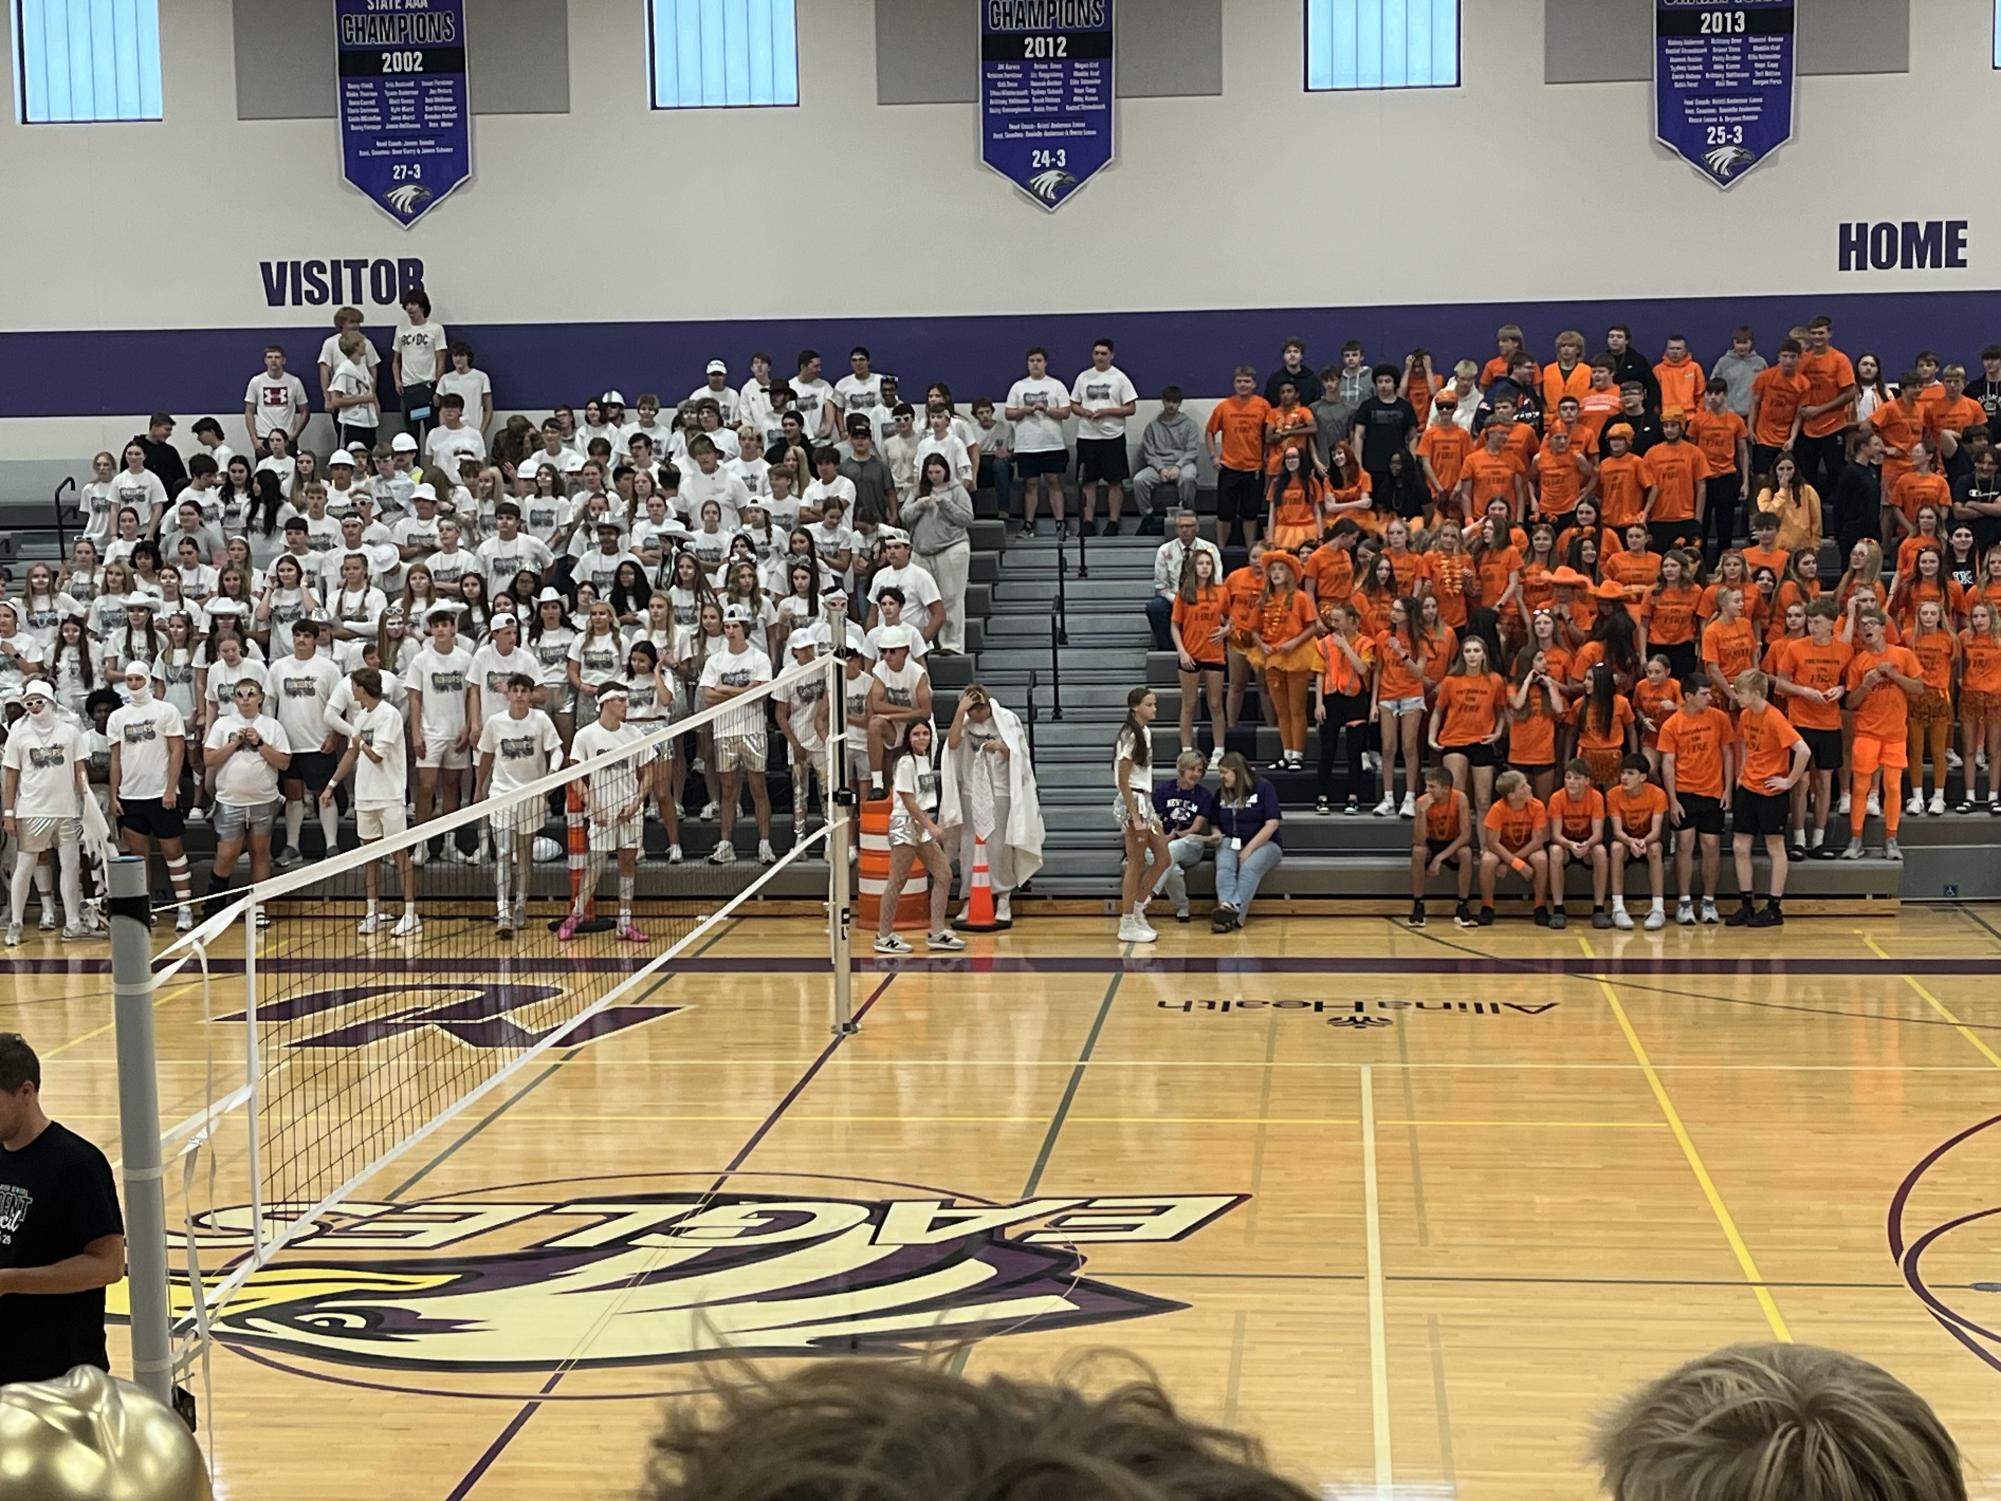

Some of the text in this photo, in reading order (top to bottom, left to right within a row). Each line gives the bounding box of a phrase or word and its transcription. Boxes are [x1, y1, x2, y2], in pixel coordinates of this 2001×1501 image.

[989, 0, 1105, 30] CHAMPIONS
[1700, 11, 1745, 34] 2013
[341, 11, 455, 45] CHAMPIONS
[1024, 36, 1067, 58] 2012
[381, 51, 424, 73] 2002
[1707, 126, 1743, 145] 25-3
[1032, 149, 1066, 168] 24-3
[393, 164, 421, 180] 27-3
[1838, 220, 1968, 272] HOME
[259, 257, 425, 306] VISITOR
[1158, 1000, 1560, 1015] Allina Health
[160, 1193, 1253, 1248] EAGLES
